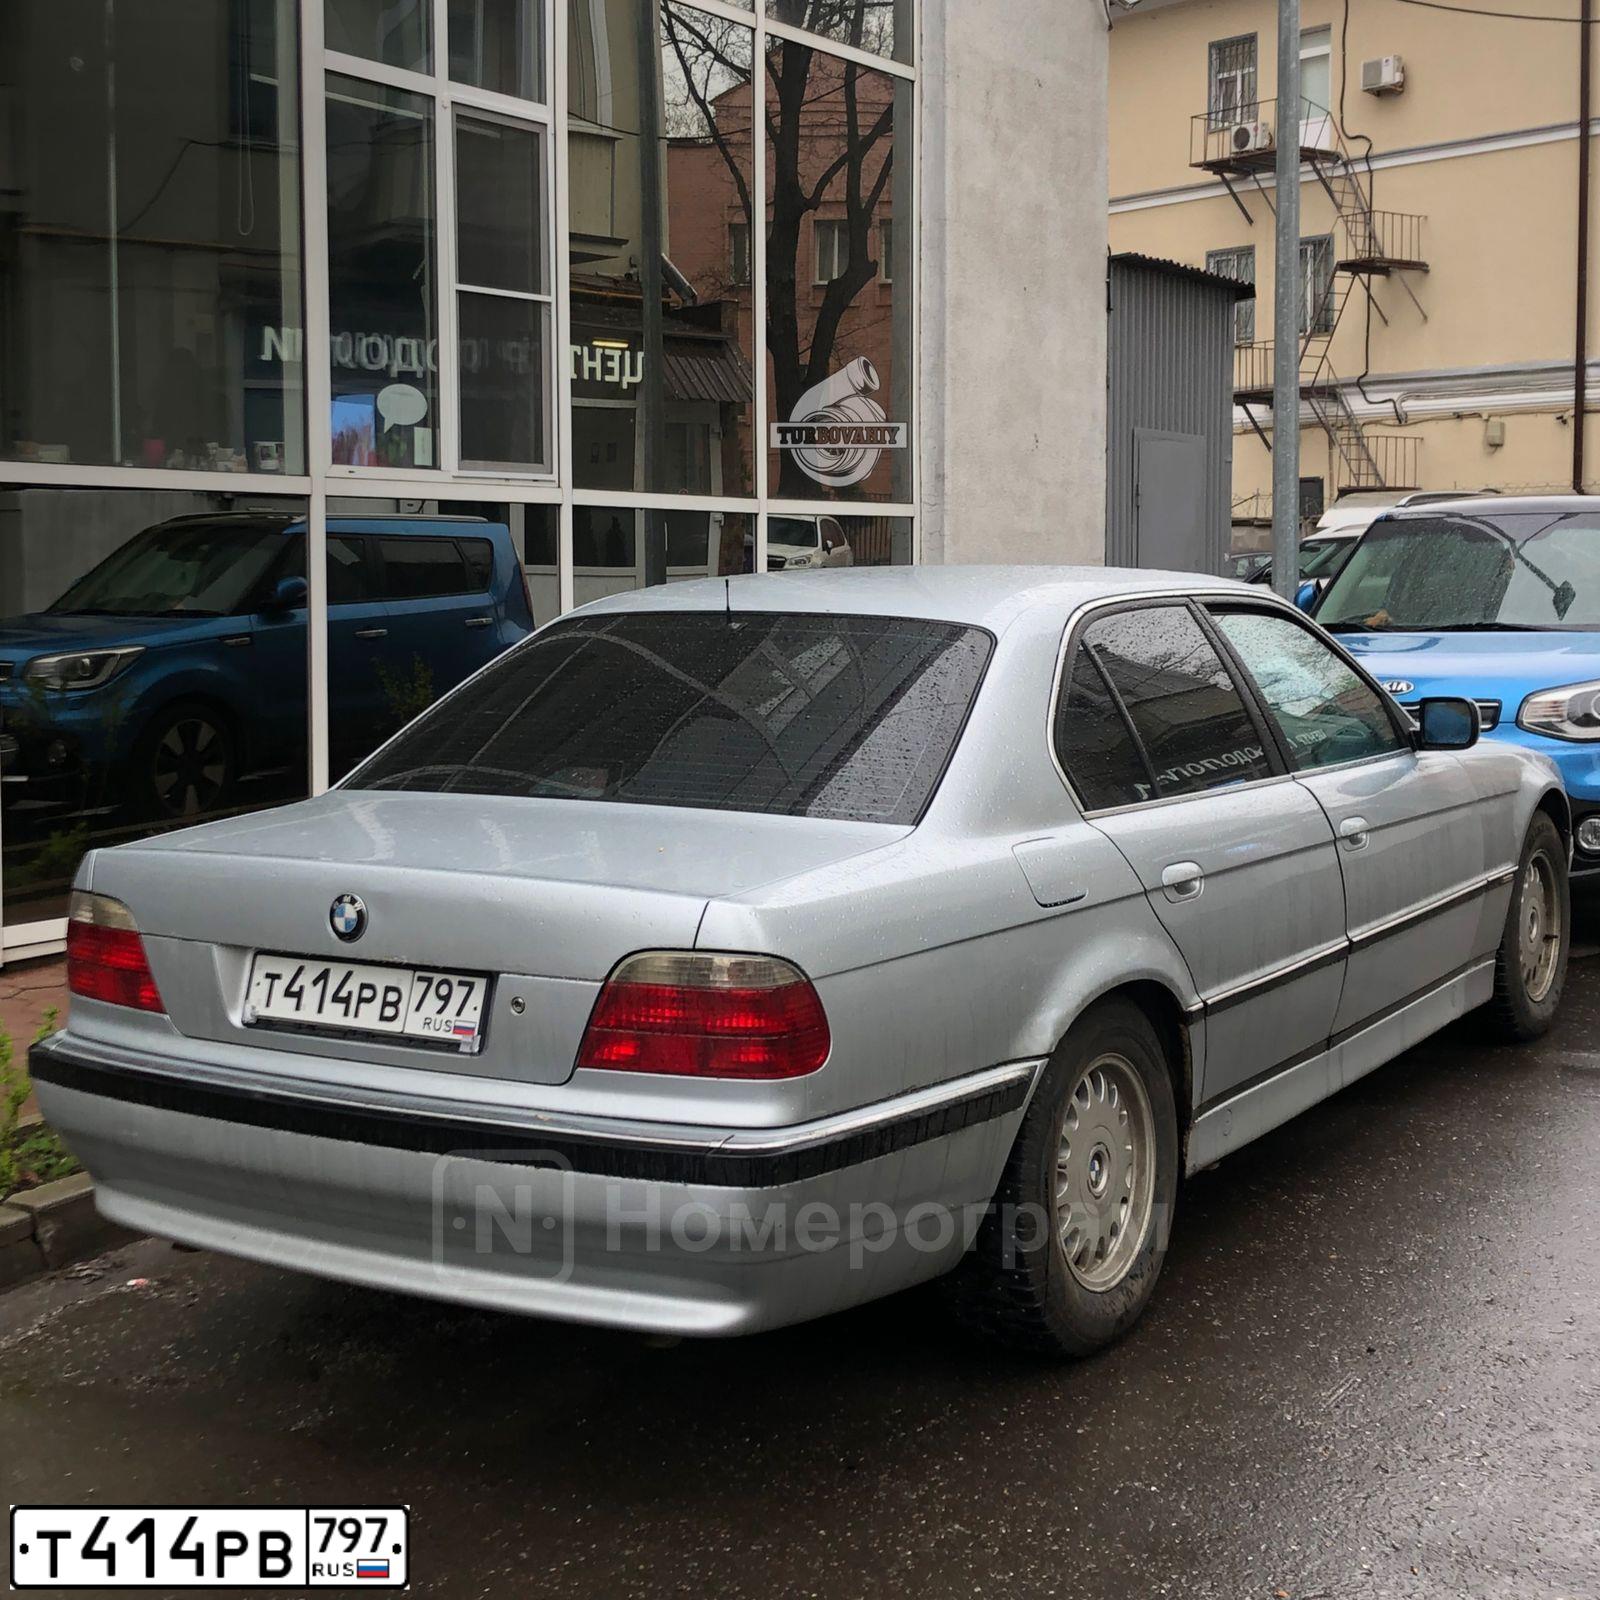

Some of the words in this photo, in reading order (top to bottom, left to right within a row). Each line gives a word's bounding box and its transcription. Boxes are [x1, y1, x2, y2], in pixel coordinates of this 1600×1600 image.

[777, 426, 900, 444] TURBOVANIY
[265, 965, 403, 1022] Т414РВ
[415, 975, 475, 1017] 797
[422, 1017, 453, 1033] RUS
